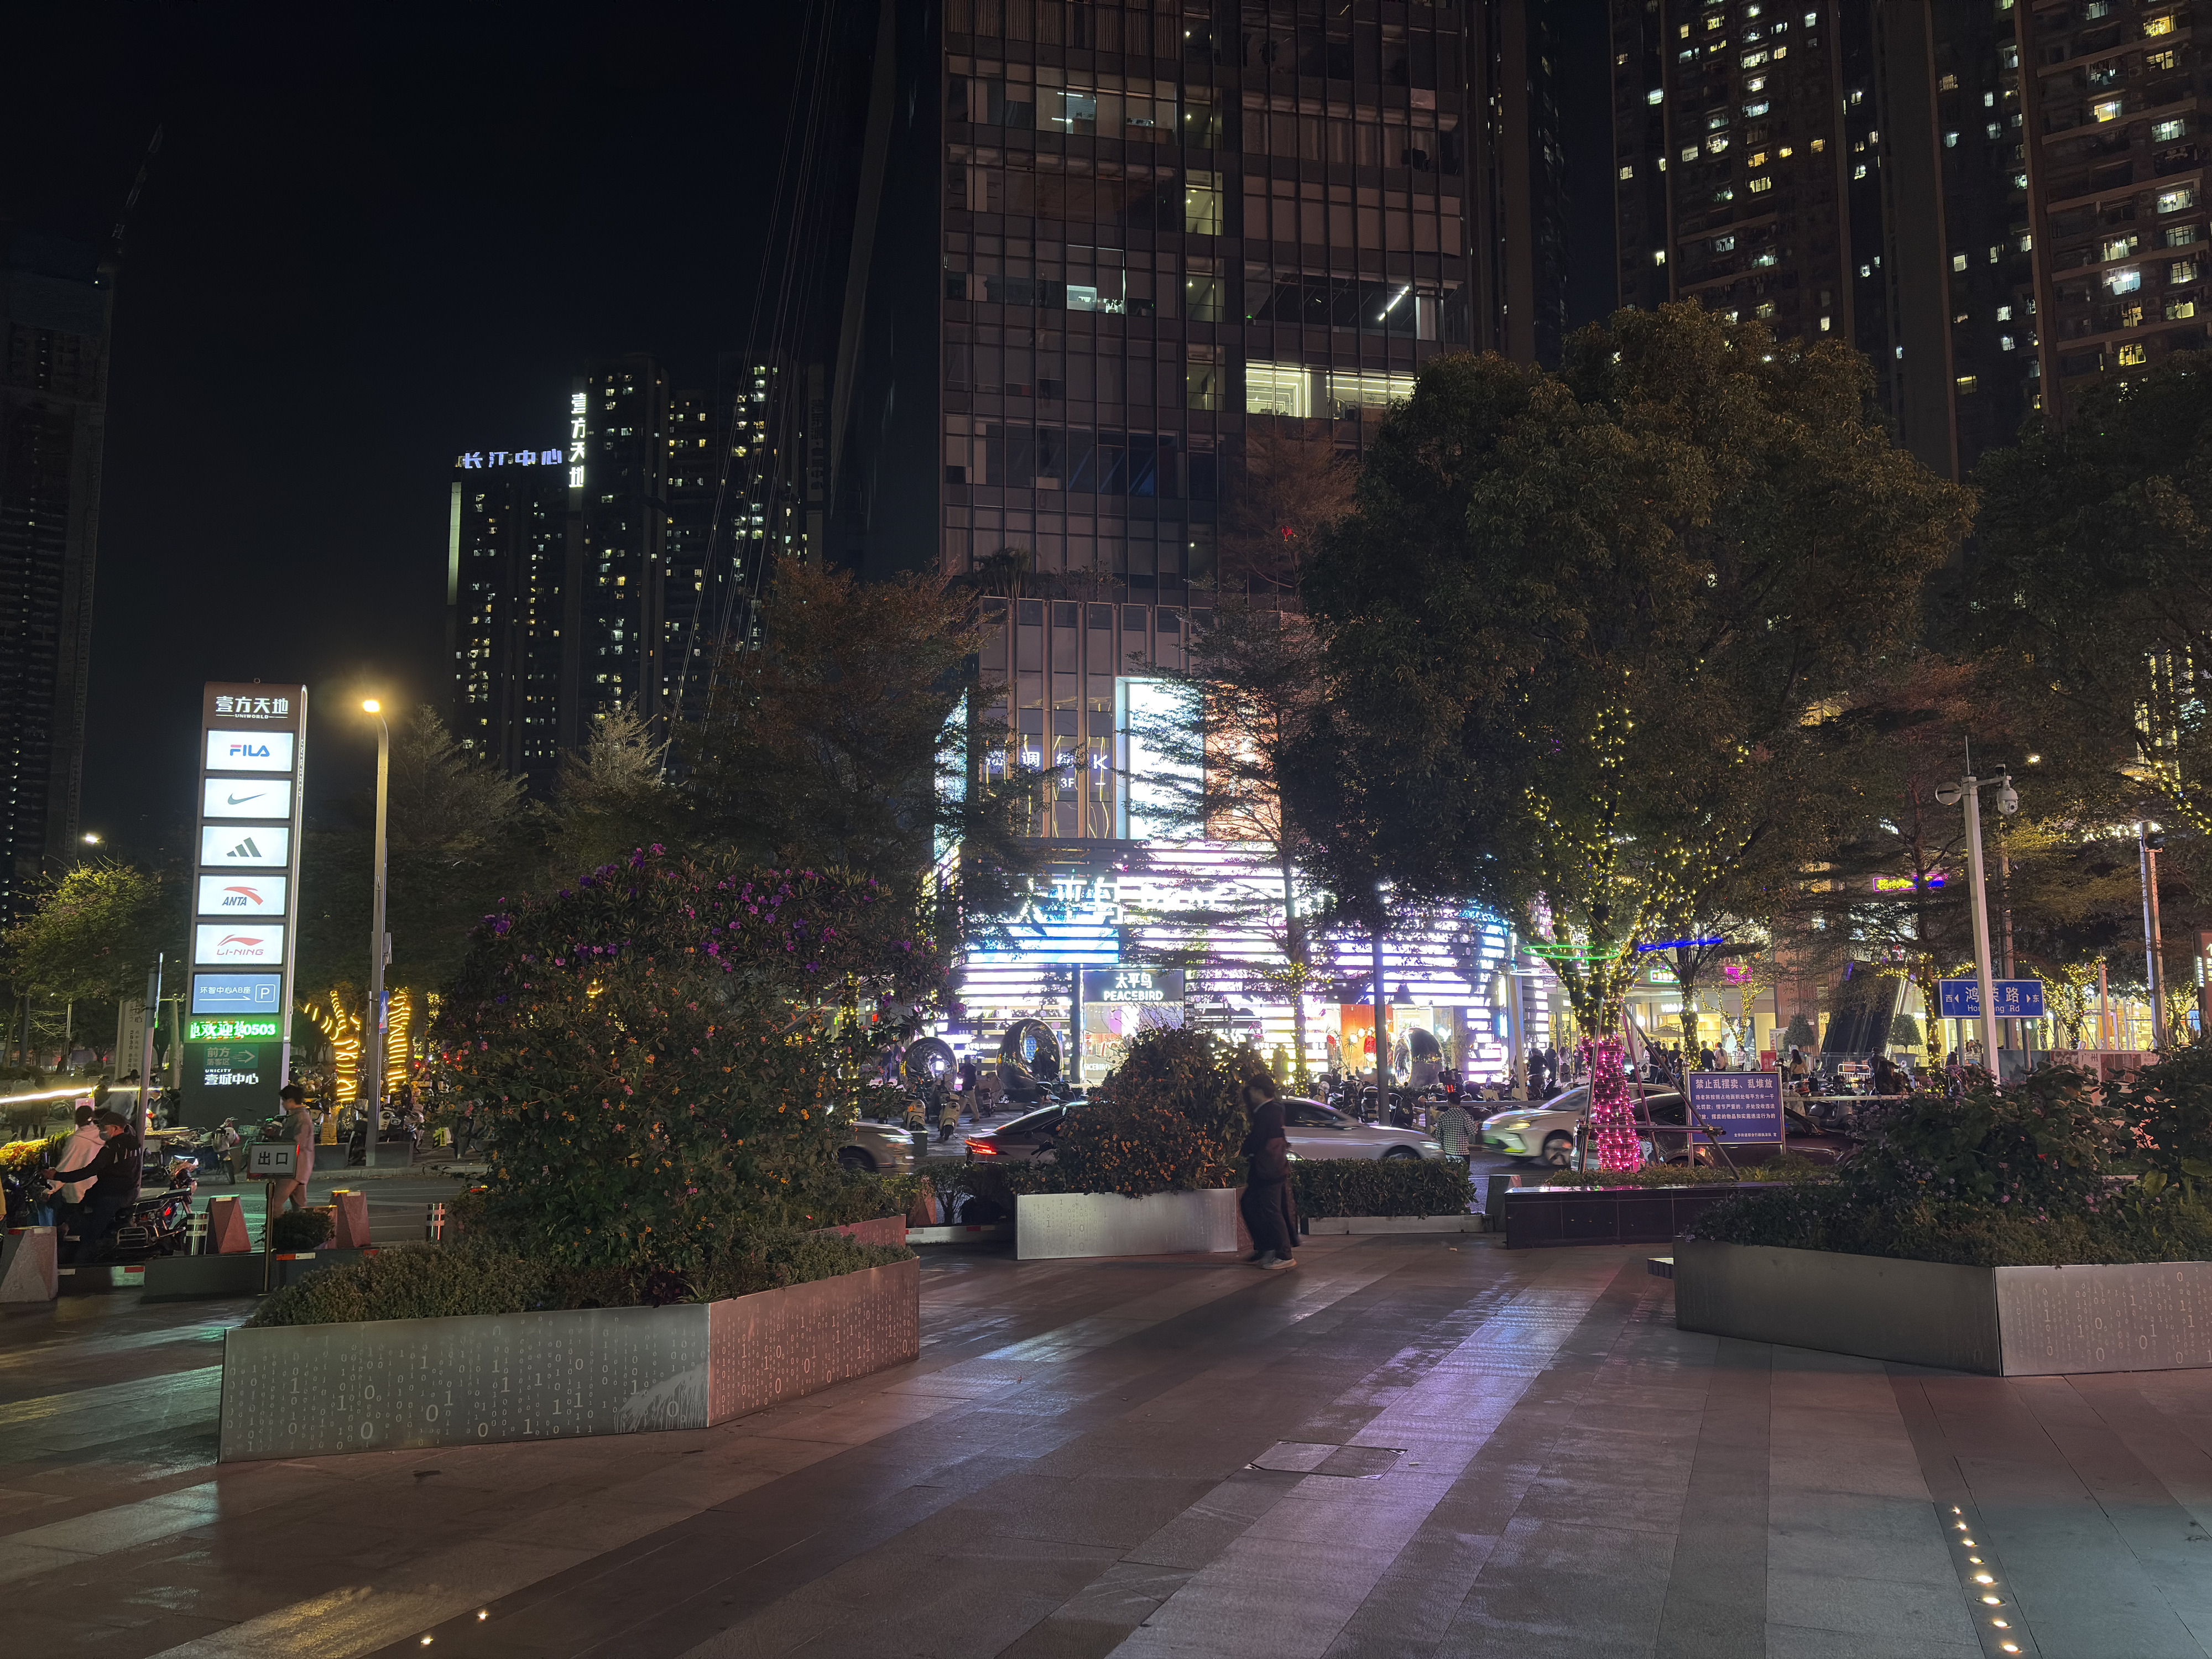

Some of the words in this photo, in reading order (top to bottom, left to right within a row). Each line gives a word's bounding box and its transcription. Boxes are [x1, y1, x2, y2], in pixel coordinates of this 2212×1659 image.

[568, 393, 587, 488] 壹方天地
[462, 448, 562, 469] 长江中心
[215, 696, 288, 714] 壹方天地
[229, 744, 270, 757] FILA
[1060, 778, 1074, 788] 3F
[222, 896, 247, 906] ANTA
[1115, 972, 1152, 989] 太平鸟
[1103, 990, 1164, 1001] PEACEBIRD
[1945, 994, 1953, 1003] 西
[2032, 994, 2039, 1003] 东
[207, 1047, 231, 1057] 前方
[205, 1073, 259, 1085] 壹城中心
[1695, 1078, 1773, 1089] 禁止乱摆卖、乱堆放
[258, 1151, 288, 1166] 出口
